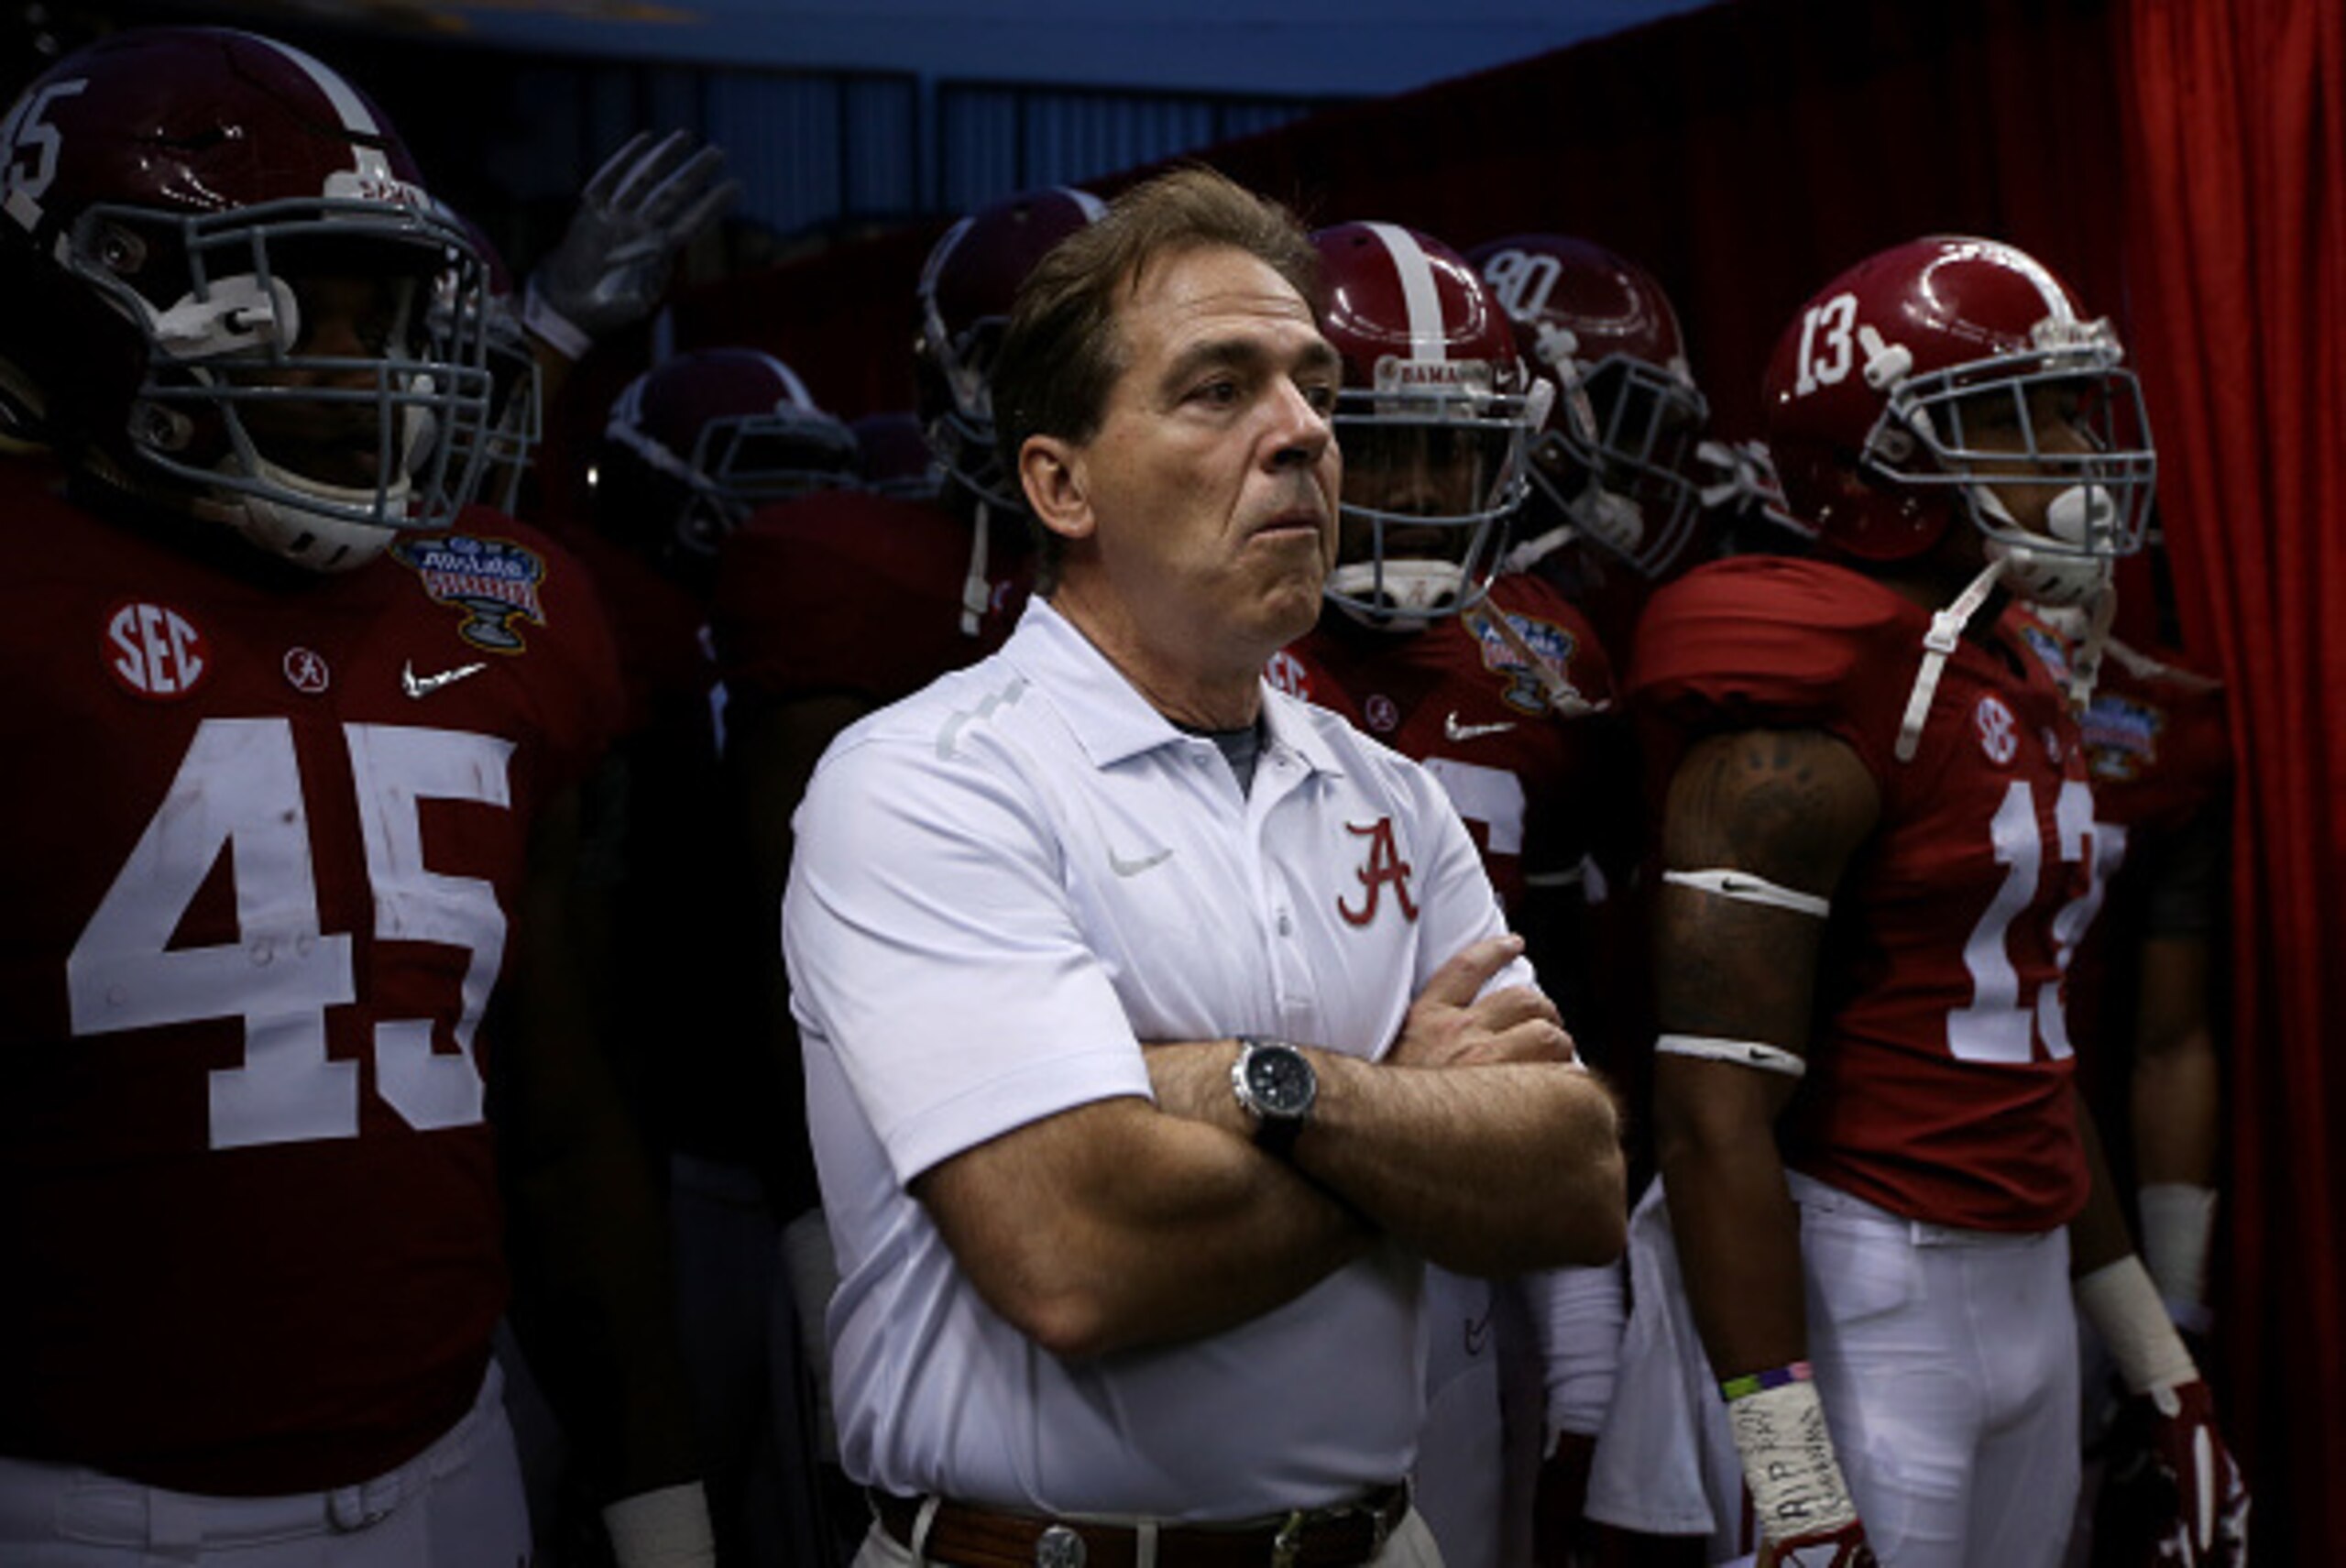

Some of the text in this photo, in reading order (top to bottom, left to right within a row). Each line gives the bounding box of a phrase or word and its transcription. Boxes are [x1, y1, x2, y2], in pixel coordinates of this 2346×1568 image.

[0, 77, 90, 203] 5
[1483, 247, 1563, 322] 90
[1401, 367, 1461, 384] BAMA
[1794, 291, 1859, 398] 13
[108, 602, 203, 693] SEC
[1266, 651, 1310, 703] EC
[1338, 816, 1420, 927] A
[65, 716, 520, 1151] 45
